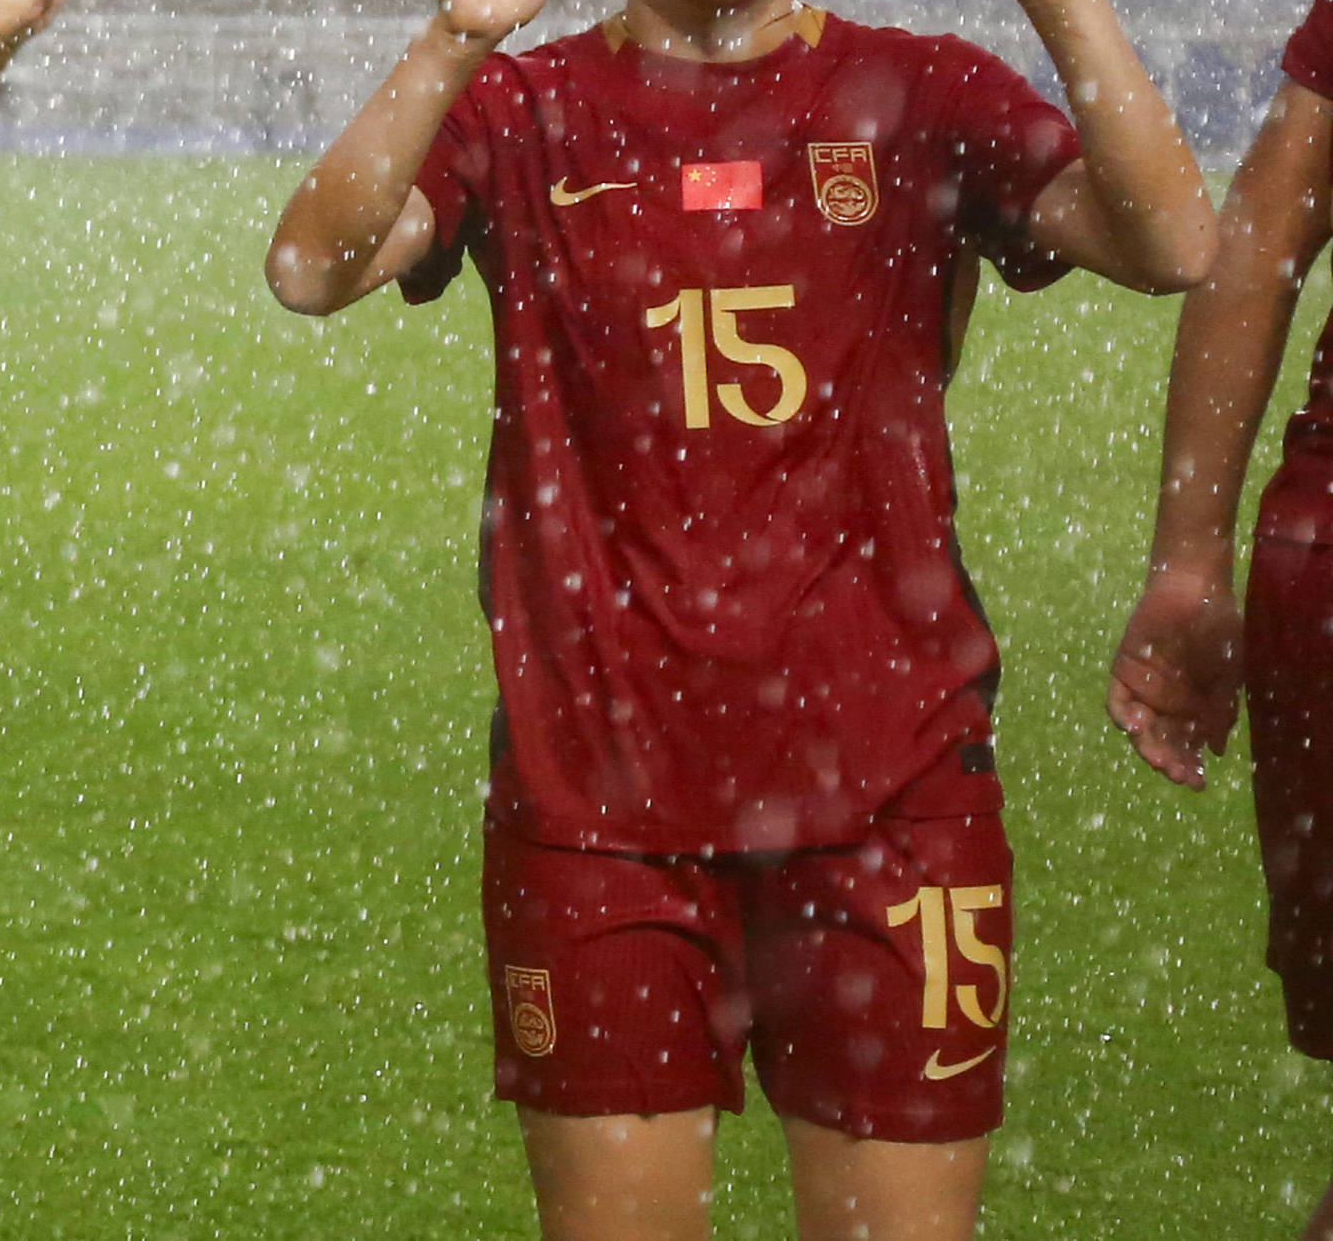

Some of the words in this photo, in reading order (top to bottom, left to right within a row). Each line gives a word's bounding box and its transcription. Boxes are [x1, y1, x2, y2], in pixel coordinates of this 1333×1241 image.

[815, 147, 867, 163] CFA
[646, 284, 807, 428] 15
[886, 884, 1006, 1028] 15
